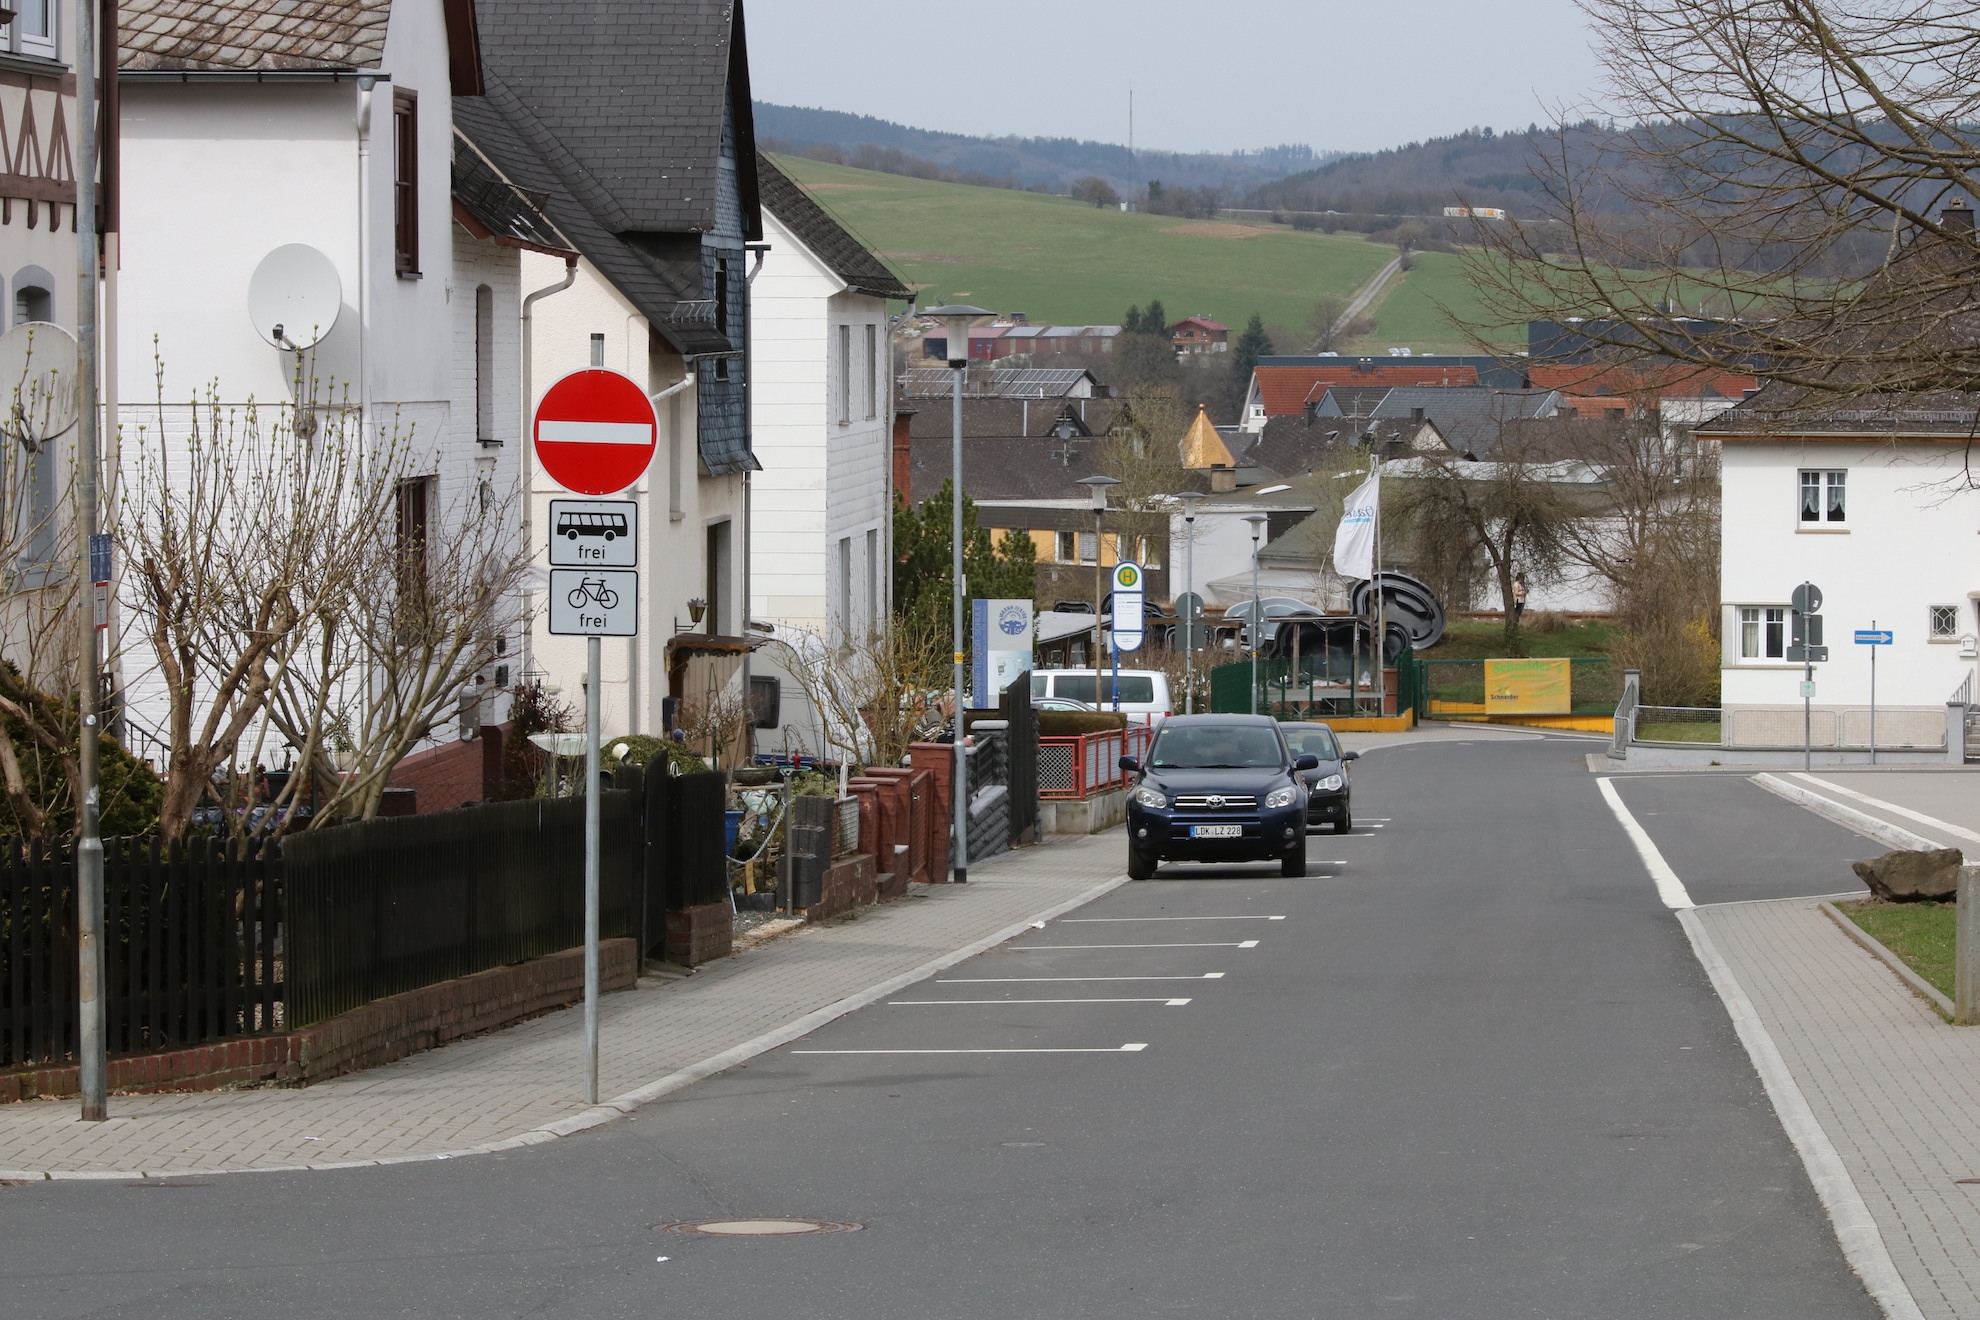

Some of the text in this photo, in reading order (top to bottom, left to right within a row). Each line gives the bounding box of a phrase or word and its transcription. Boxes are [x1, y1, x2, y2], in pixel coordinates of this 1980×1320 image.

[578, 544, 605, 559] frei
[1123, 570, 1132, 582] H
[579, 613, 607, 628] frei
[1195, 826, 1241, 836] LDK LZ 228
